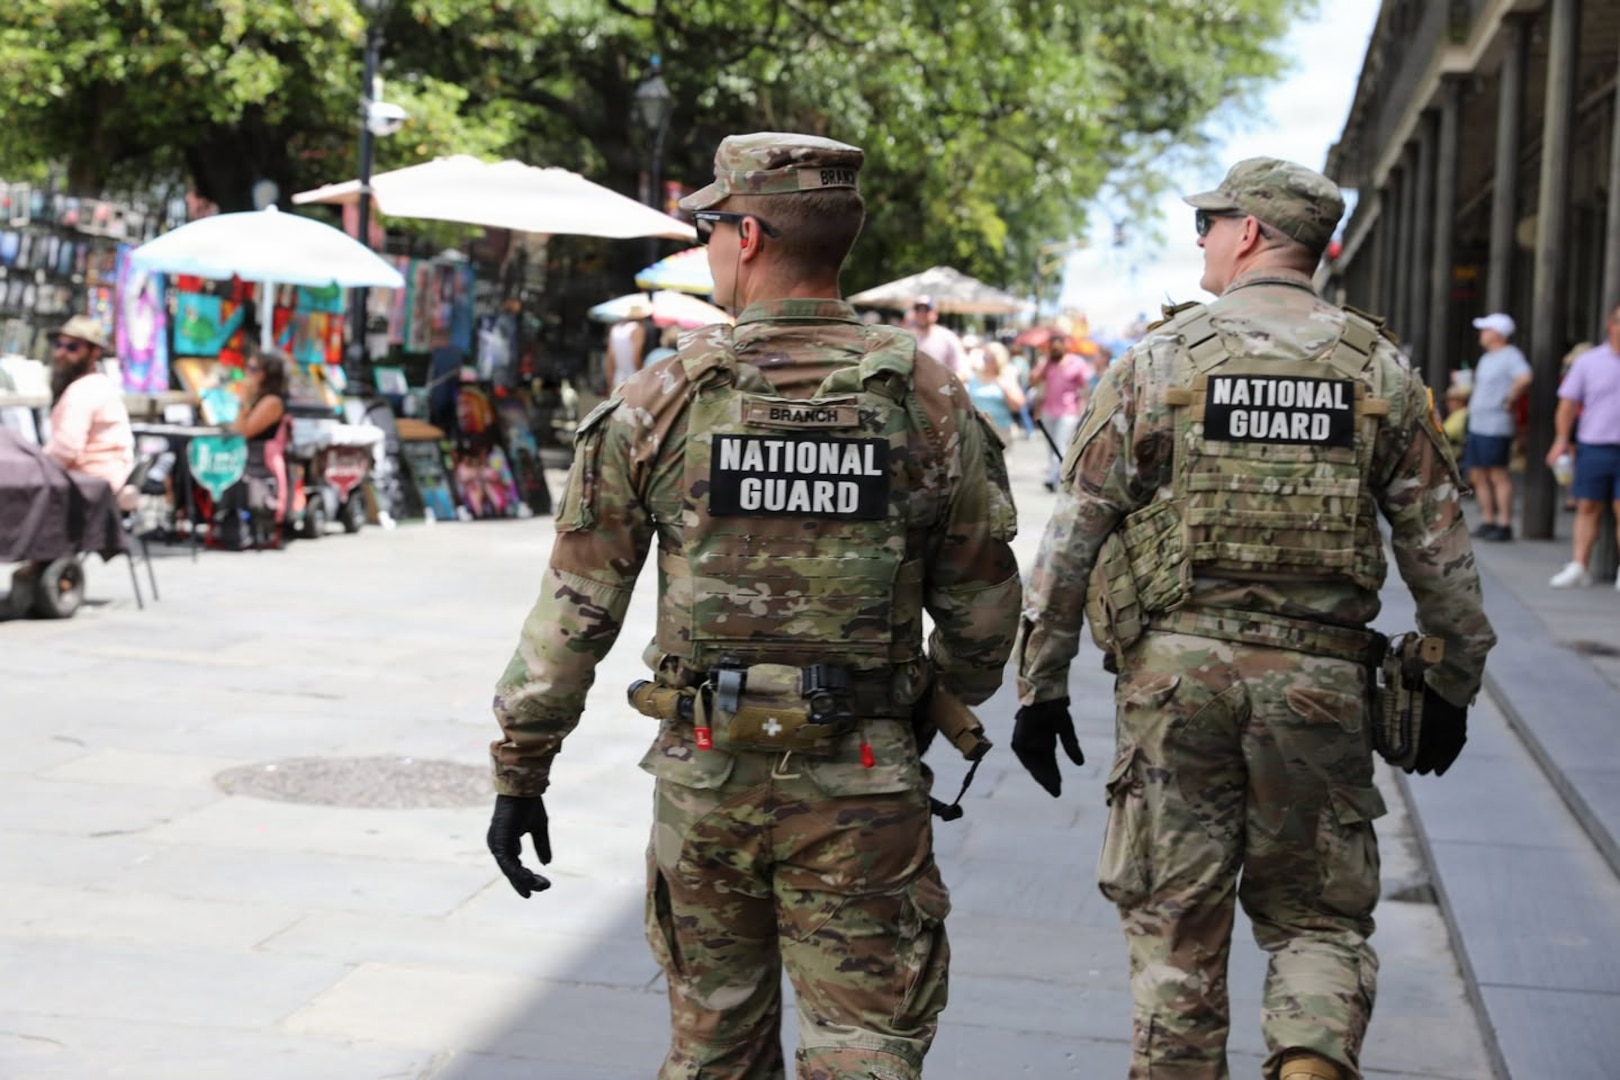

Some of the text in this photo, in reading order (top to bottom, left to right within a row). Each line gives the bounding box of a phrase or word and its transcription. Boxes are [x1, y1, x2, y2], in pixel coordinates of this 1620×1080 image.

[1213, 378, 1349, 410] NATIONAL
[769, 407, 838, 422] BRANCH
[1229, 409, 1331, 441] GUARD
[720, 438, 883, 476] NATIONAL
[739, 477, 859, 513] GUARD
